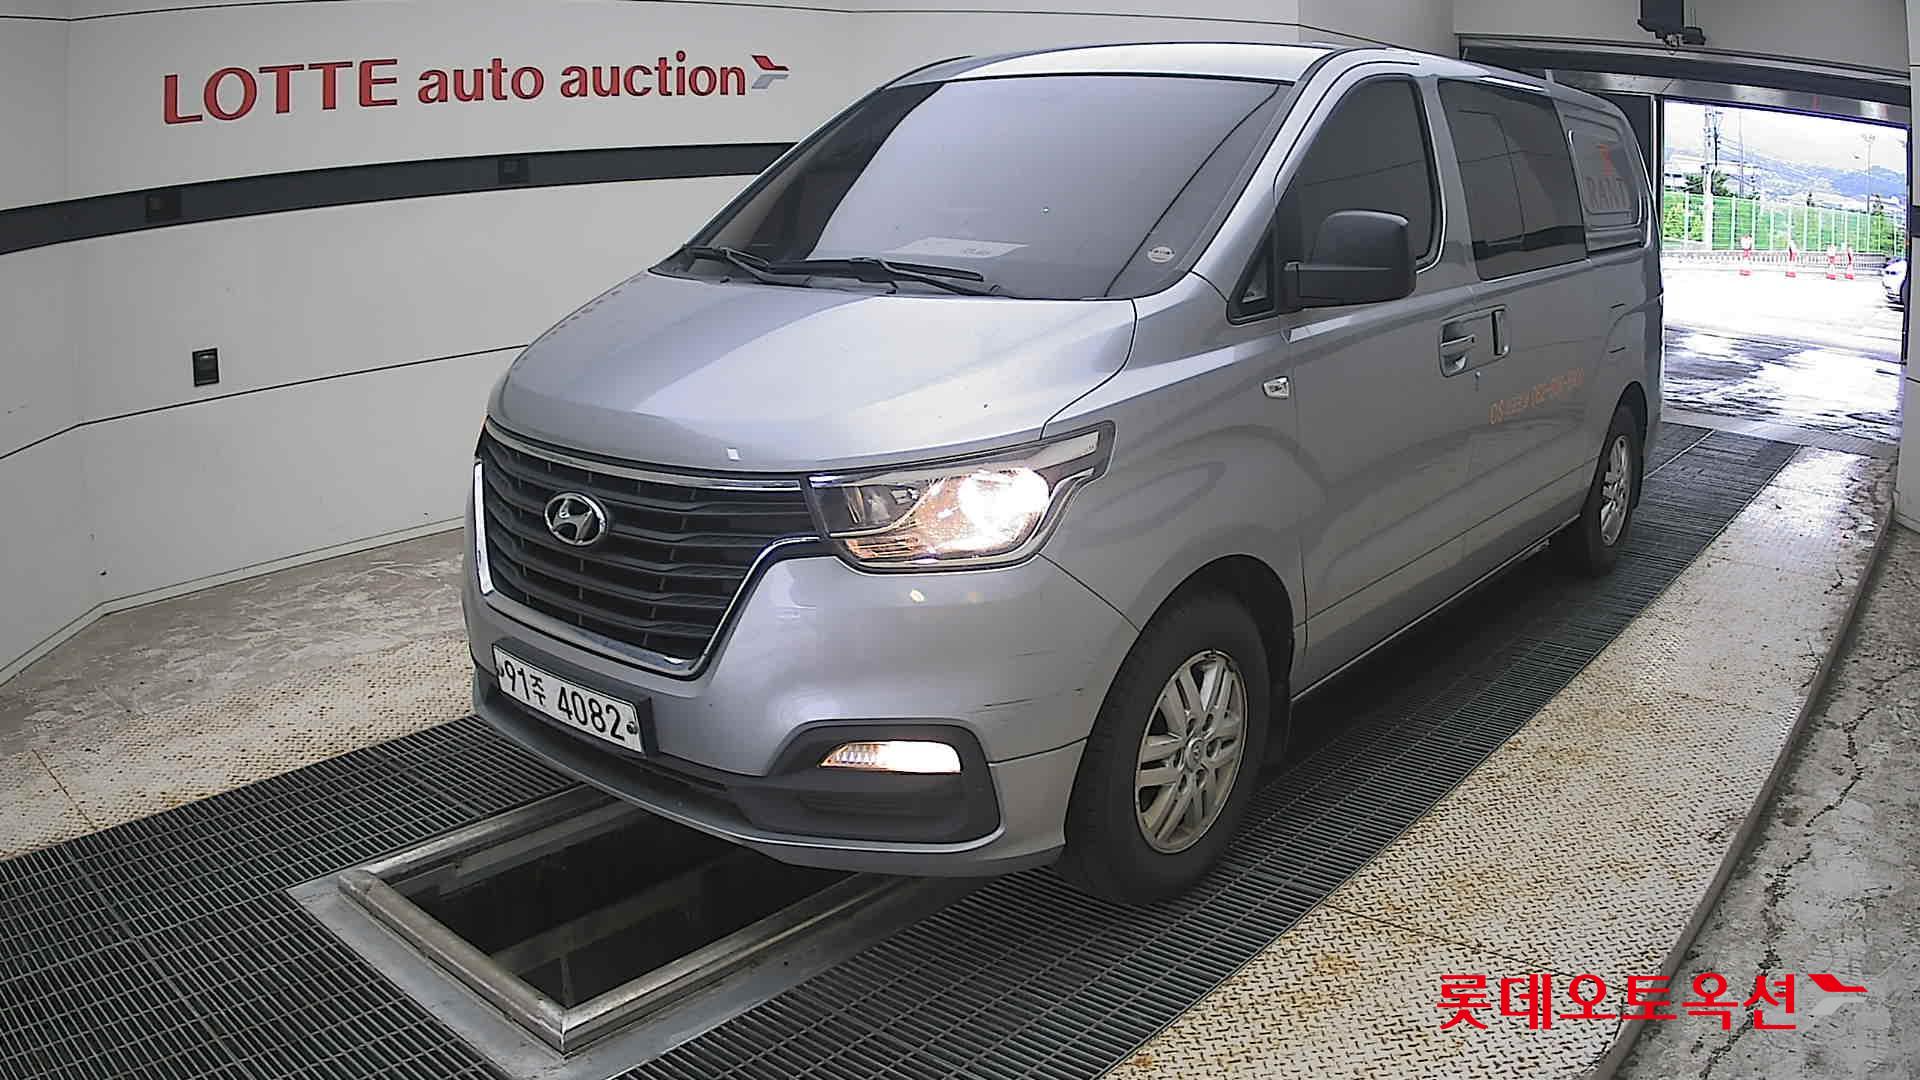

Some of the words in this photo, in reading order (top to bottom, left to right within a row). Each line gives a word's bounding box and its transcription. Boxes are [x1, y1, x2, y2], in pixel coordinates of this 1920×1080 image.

[163, 58, 398, 125] LOTTE
[418, 57, 545, 104] auto
[560, 50, 747, 99] auction
[504, 660, 546, 705] 91주
[558, 687, 625, 741] 4082
